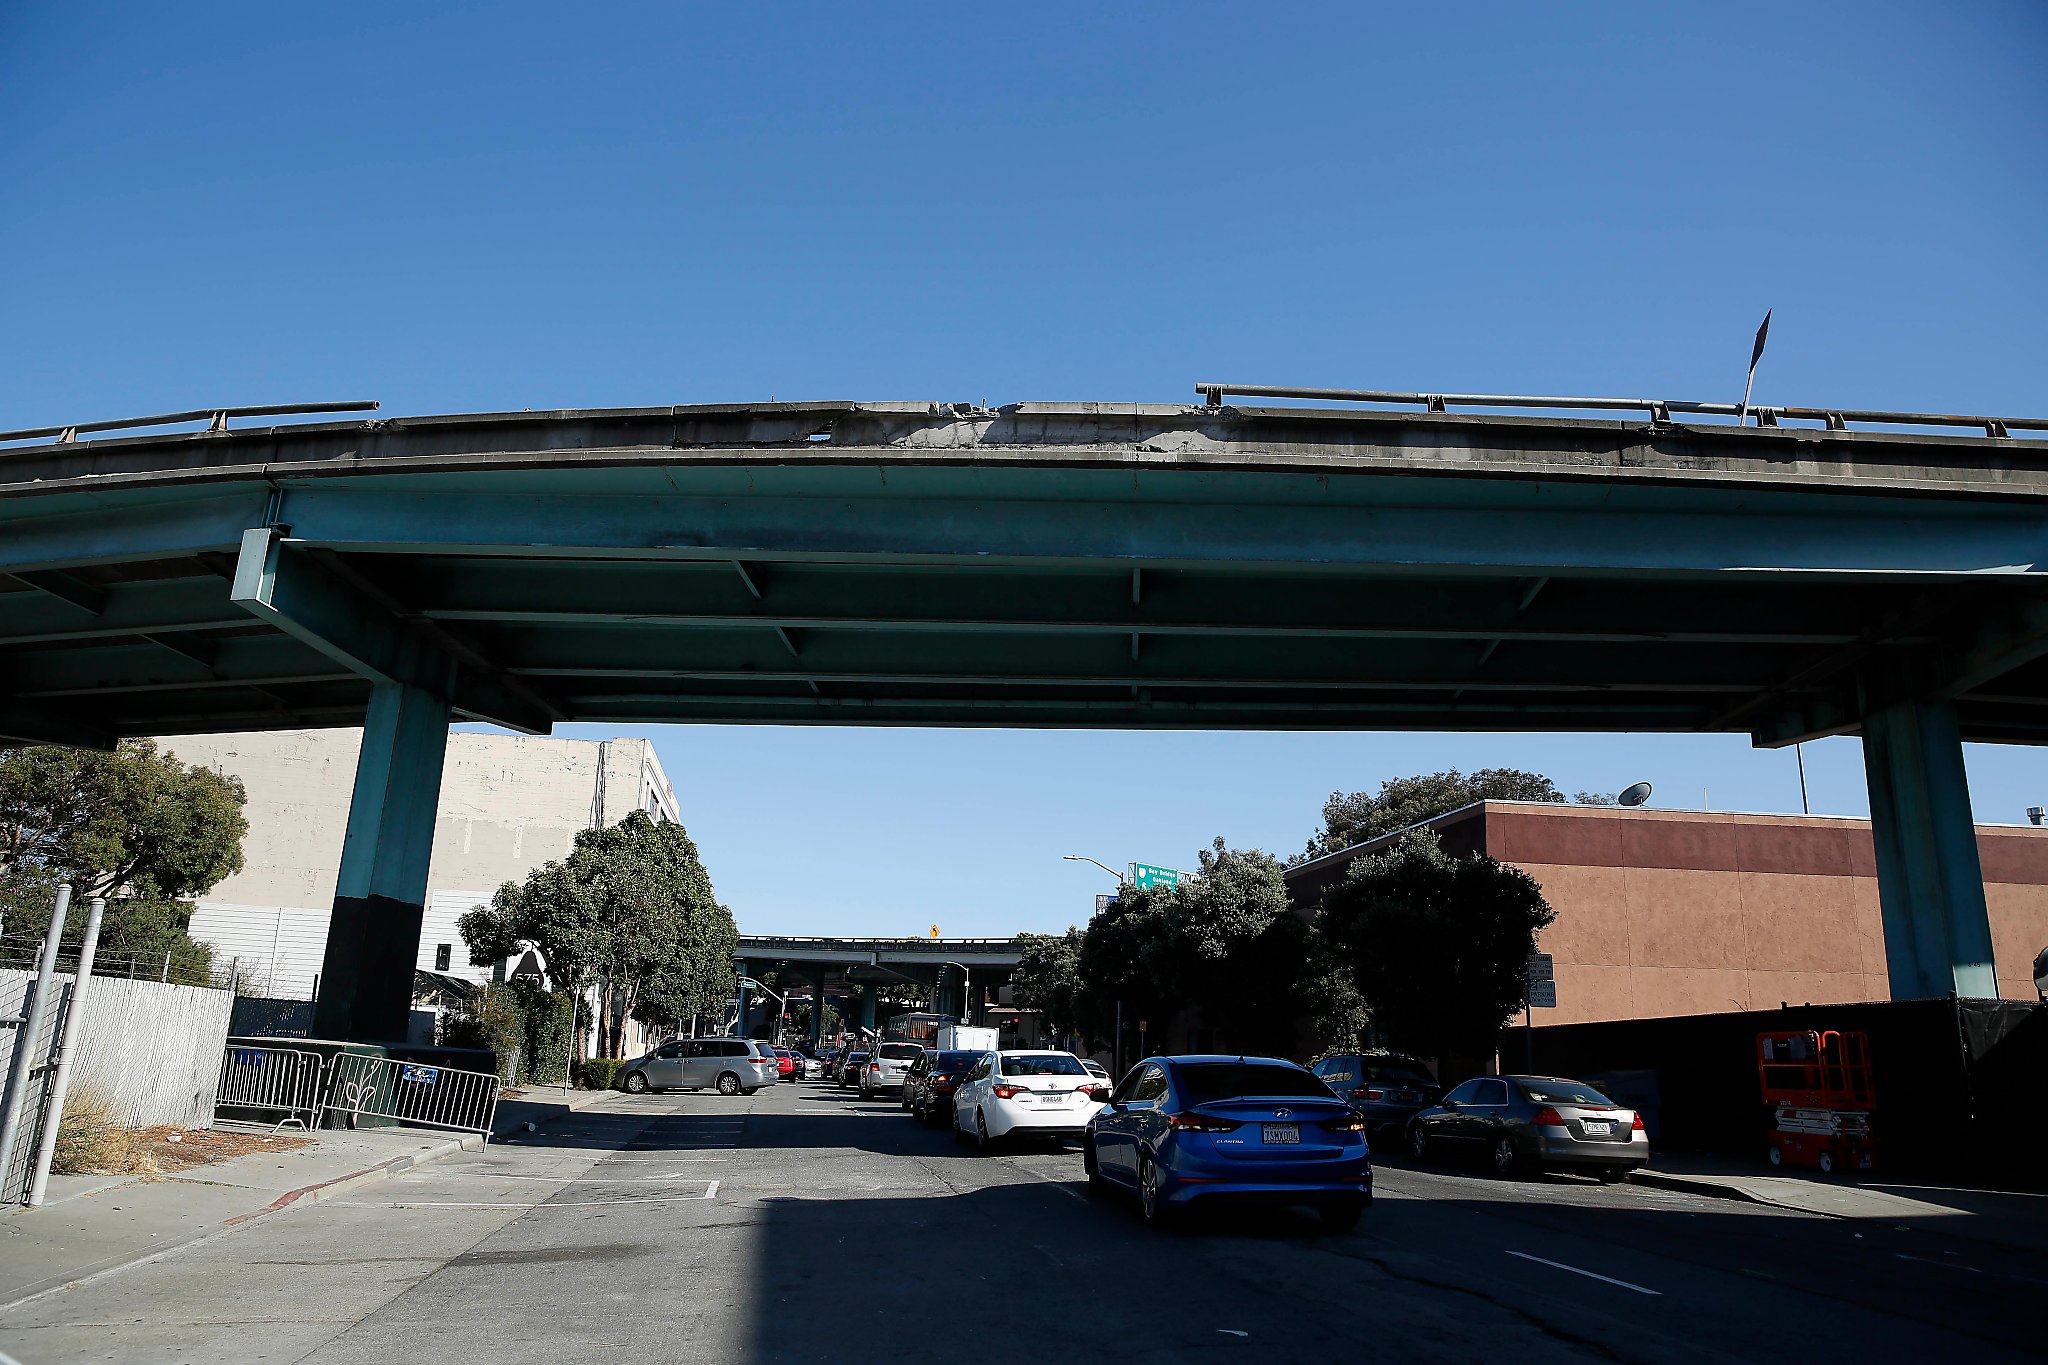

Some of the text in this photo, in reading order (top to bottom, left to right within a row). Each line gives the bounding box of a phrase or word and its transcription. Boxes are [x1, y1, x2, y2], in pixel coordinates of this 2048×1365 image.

[1148, 867, 1176, 878] Bay Bridge
[1152, 877, 1172, 885] Oakland
[515, 973, 540, 985] 575
[1530, 982, 1537, 990] 2
[1264, 1130, 1299, 1141] 7SMX004
